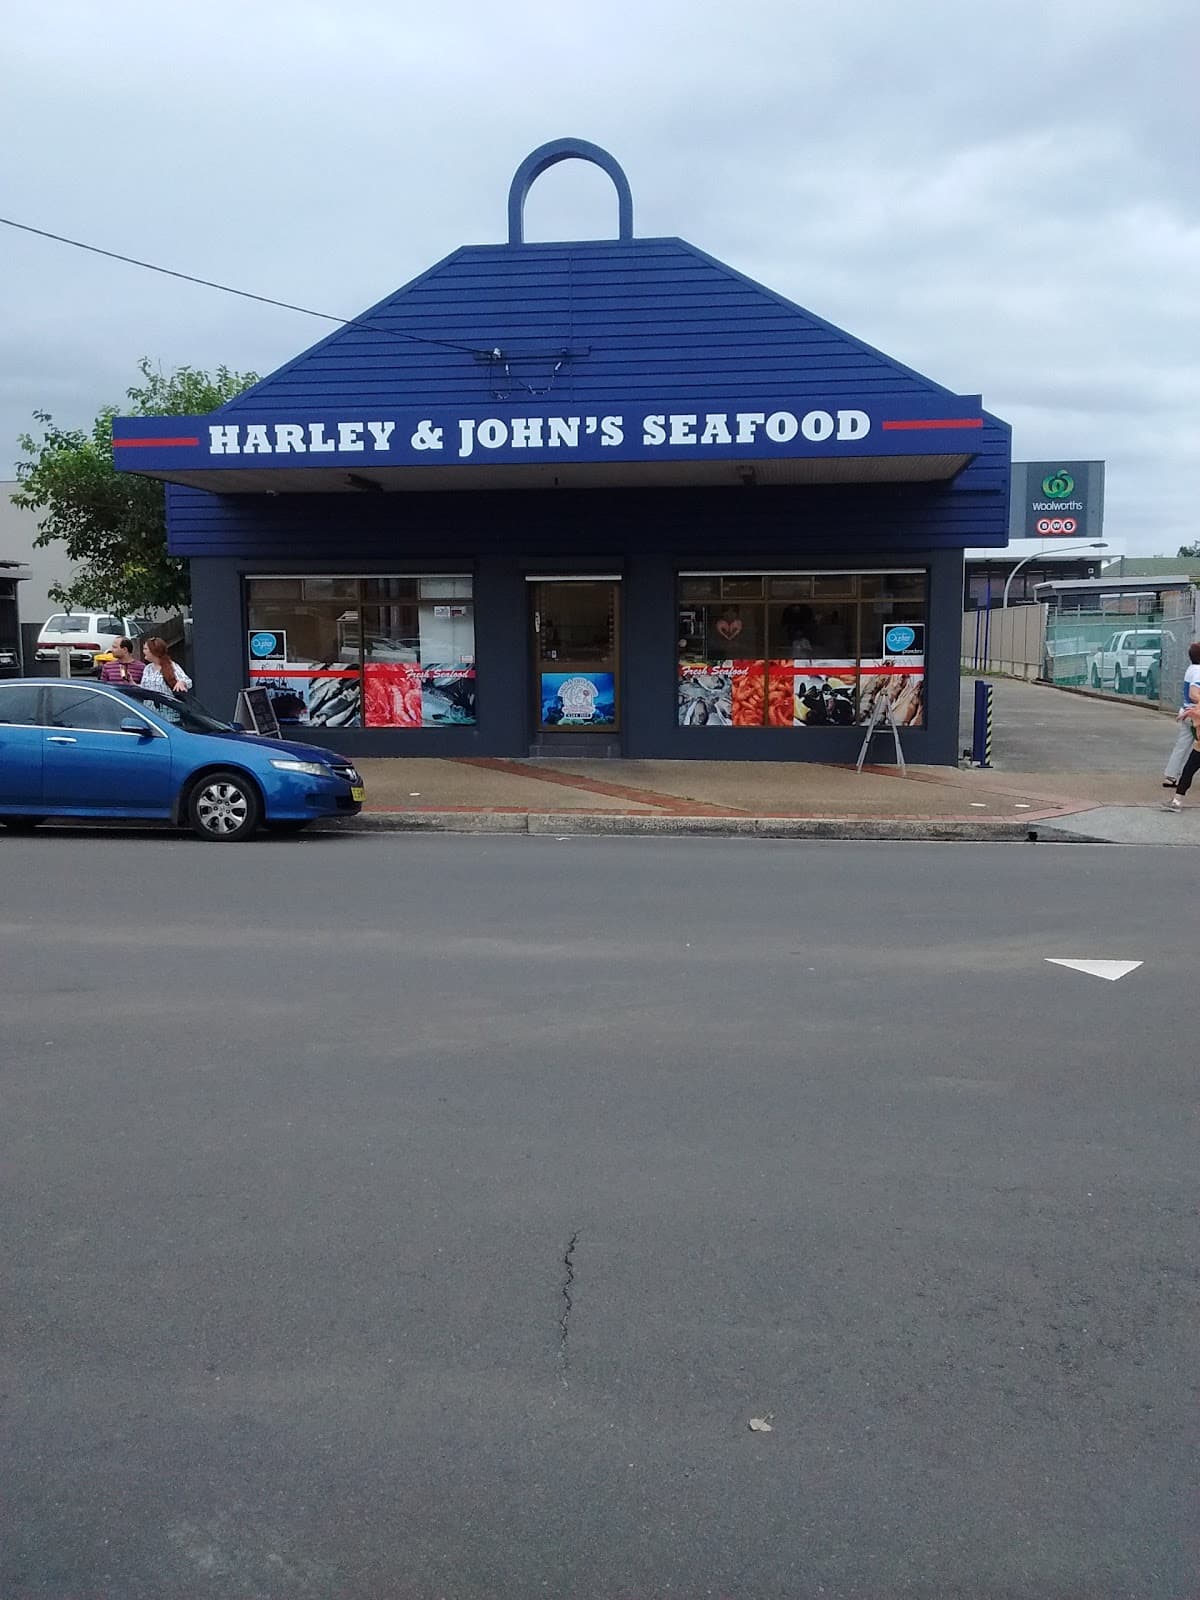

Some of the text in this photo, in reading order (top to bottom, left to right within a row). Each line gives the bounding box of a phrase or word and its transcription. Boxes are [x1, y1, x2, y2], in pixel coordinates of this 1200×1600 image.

[209, 409, 871, 457] HARLEY & JOHN'S SEAFOOD
[1032, 501, 1083, 511] woolworths
[682, 665, 750, 678] Fresh Seafood
